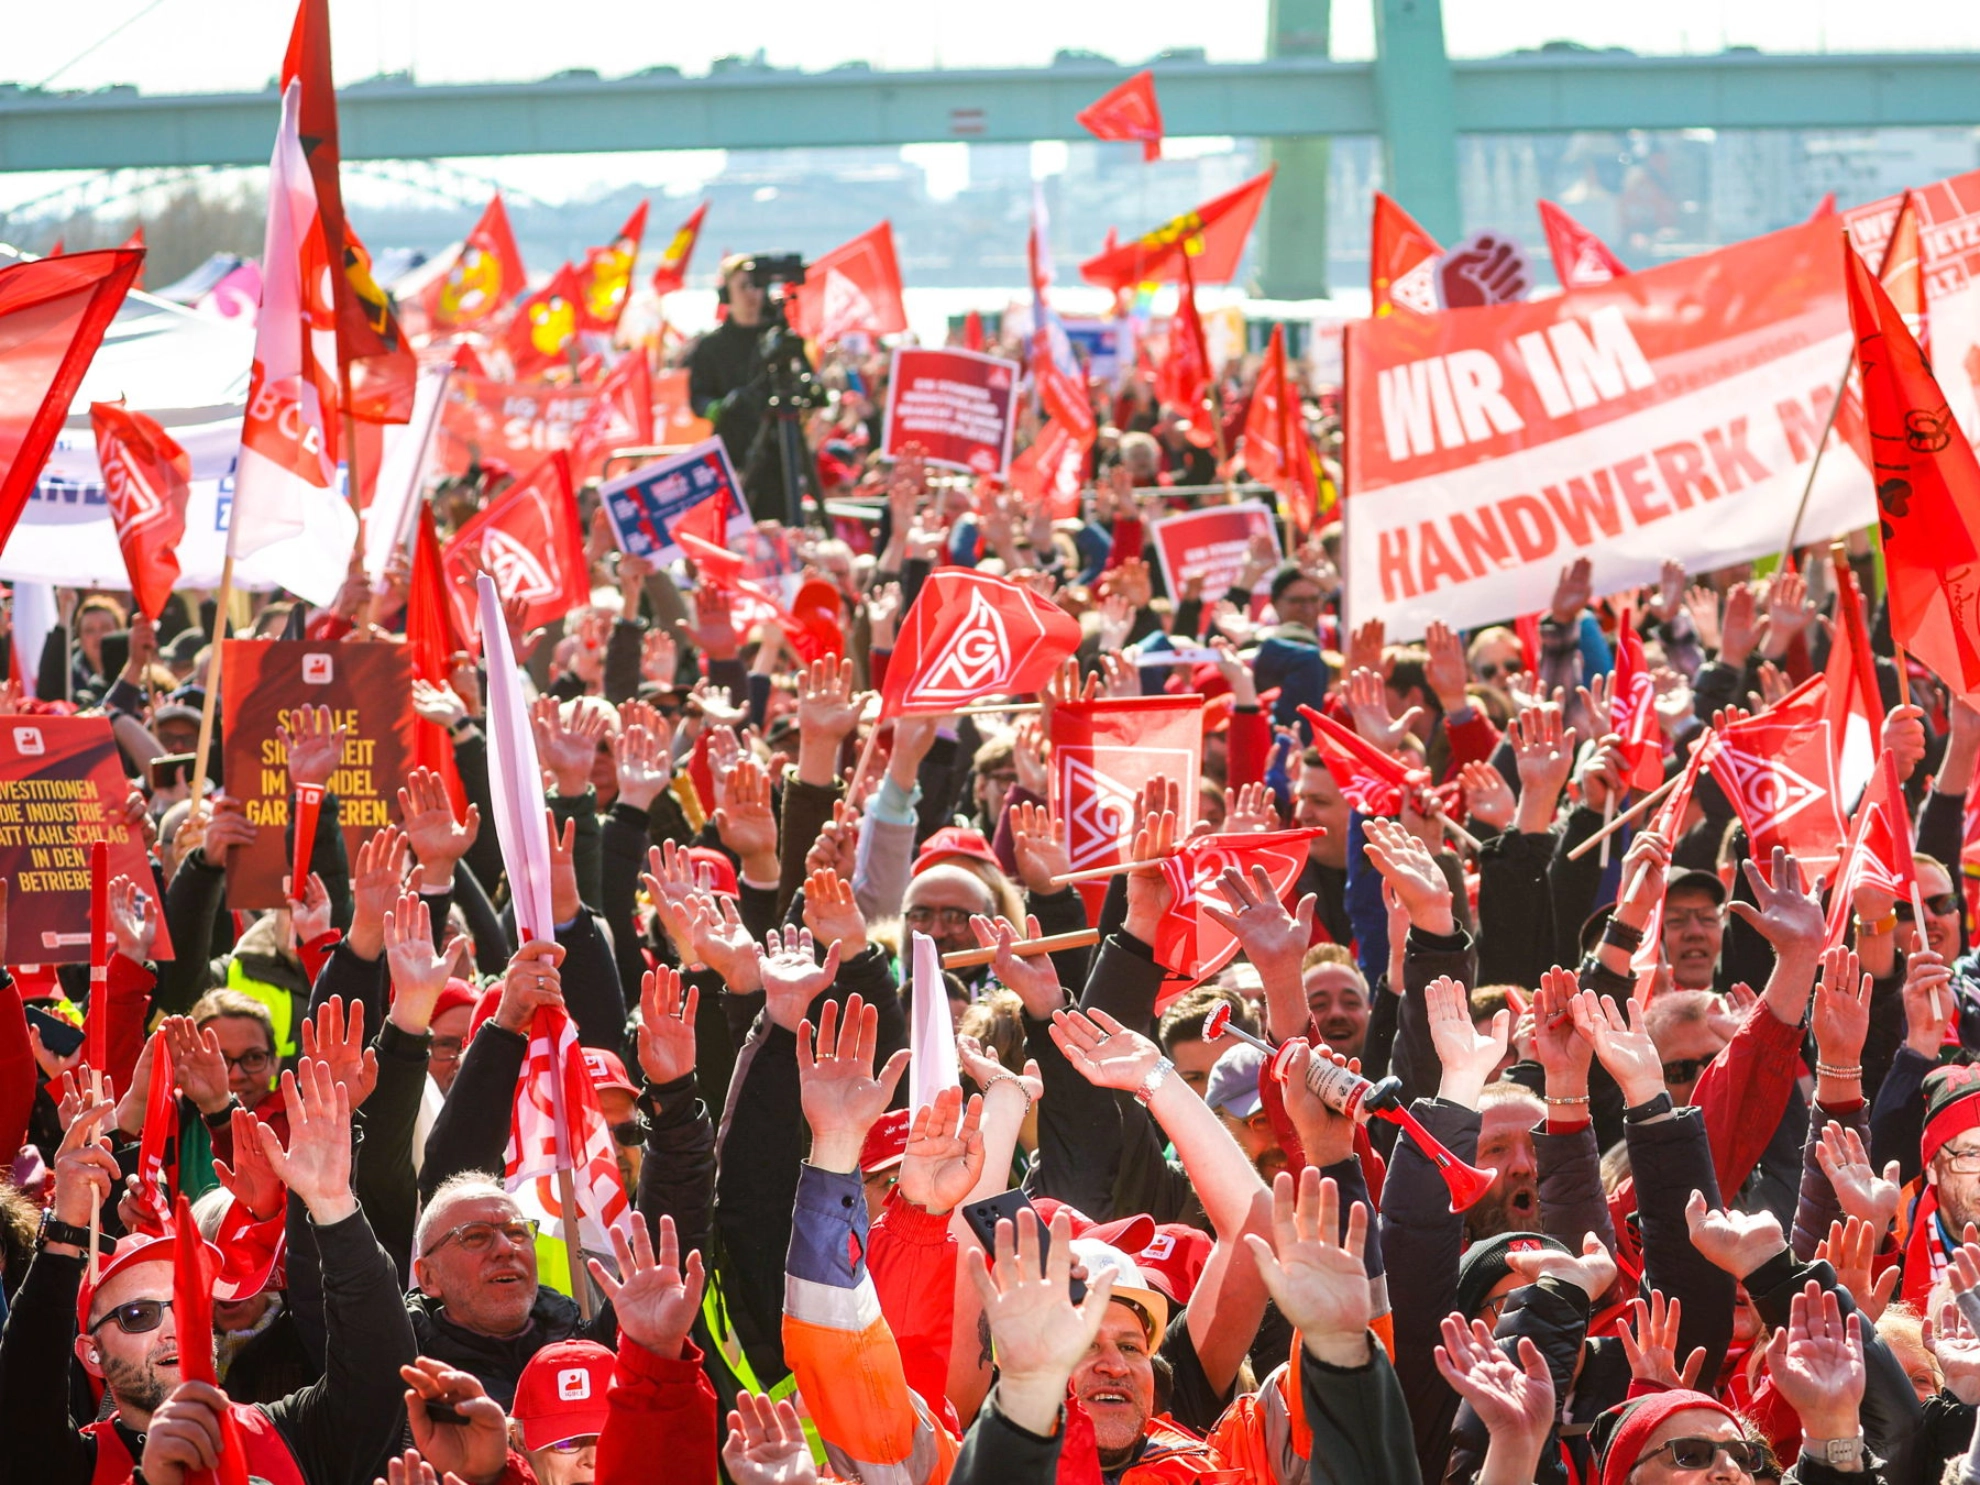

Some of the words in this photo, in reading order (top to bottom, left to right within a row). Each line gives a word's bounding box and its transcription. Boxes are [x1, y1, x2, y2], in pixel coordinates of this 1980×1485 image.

[1377, 348, 1525, 462] WIR
[1516, 305, 1656, 420] IM
[1377, 415, 1773, 602] HANDWERK
[0, 780, 98, 800] VESTITIONEN
[261, 769, 287, 796] IM
[0, 803, 24, 822] DIE
[26, 803, 106, 822] INDUSTRIE
[25, 825, 129, 846] KAHLSCHLAG
[31, 848, 50, 868] IN
[53, 848, 86, 868] DEN
[18, 871, 93, 891] BETRIEBE
